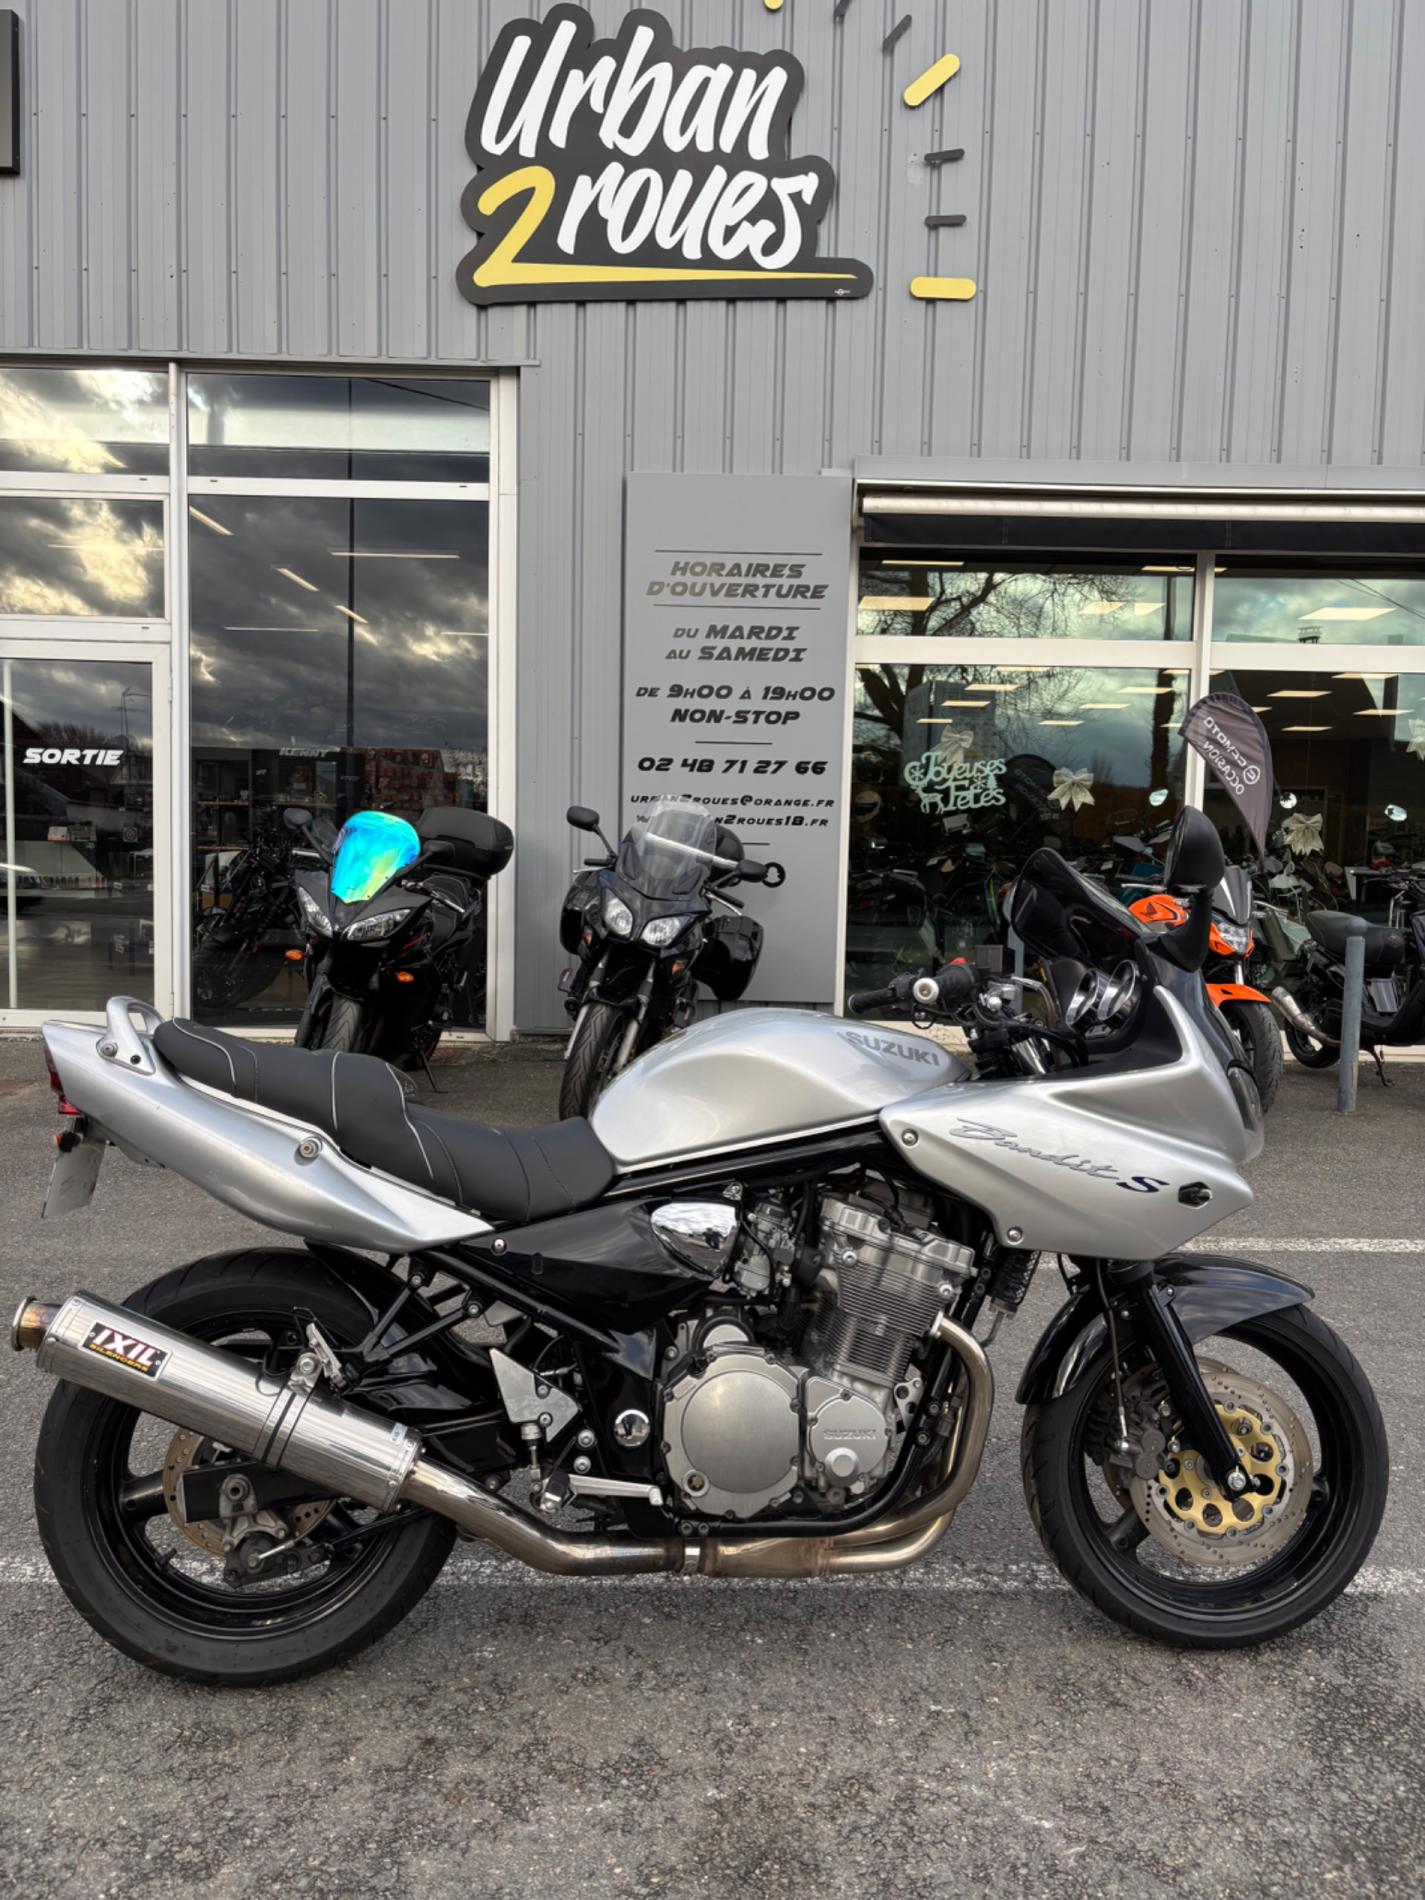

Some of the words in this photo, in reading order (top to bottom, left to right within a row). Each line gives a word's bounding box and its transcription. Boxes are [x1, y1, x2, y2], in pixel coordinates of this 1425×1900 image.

[480, 20, 789, 160] Urban
[670, 561, 806, 579] HORAIRES
[646, 581, 829, 600] D'OUVERTURE
[672, 627, 700, 639] DU
[705, 624, 801, 641] MARDI
[664, 649, 692, 660] AU
[698, 646, 808, 662] SAMEDI
[635, 686, 661, 698] DE
[670, 708, 801, 725] NON-STOP
[23, 748, 124, 765] SORTIE
[637, 757, 675, 772] 02
[680, 758, 716, 773] 48
[720, 759, 749, 774] 71
[752, 760, 788, 775] 27
[794, 761, 829, 775] 66
[846, 1032, 941, 1067] SUZUKI
[949, 1118, 1120, 1180] Bandit
[1116, 1175, 1170, 1193] S
[91, 1327, 156, 1367] IXIL
[823, 1429, 877, 1440] SUZUKI
